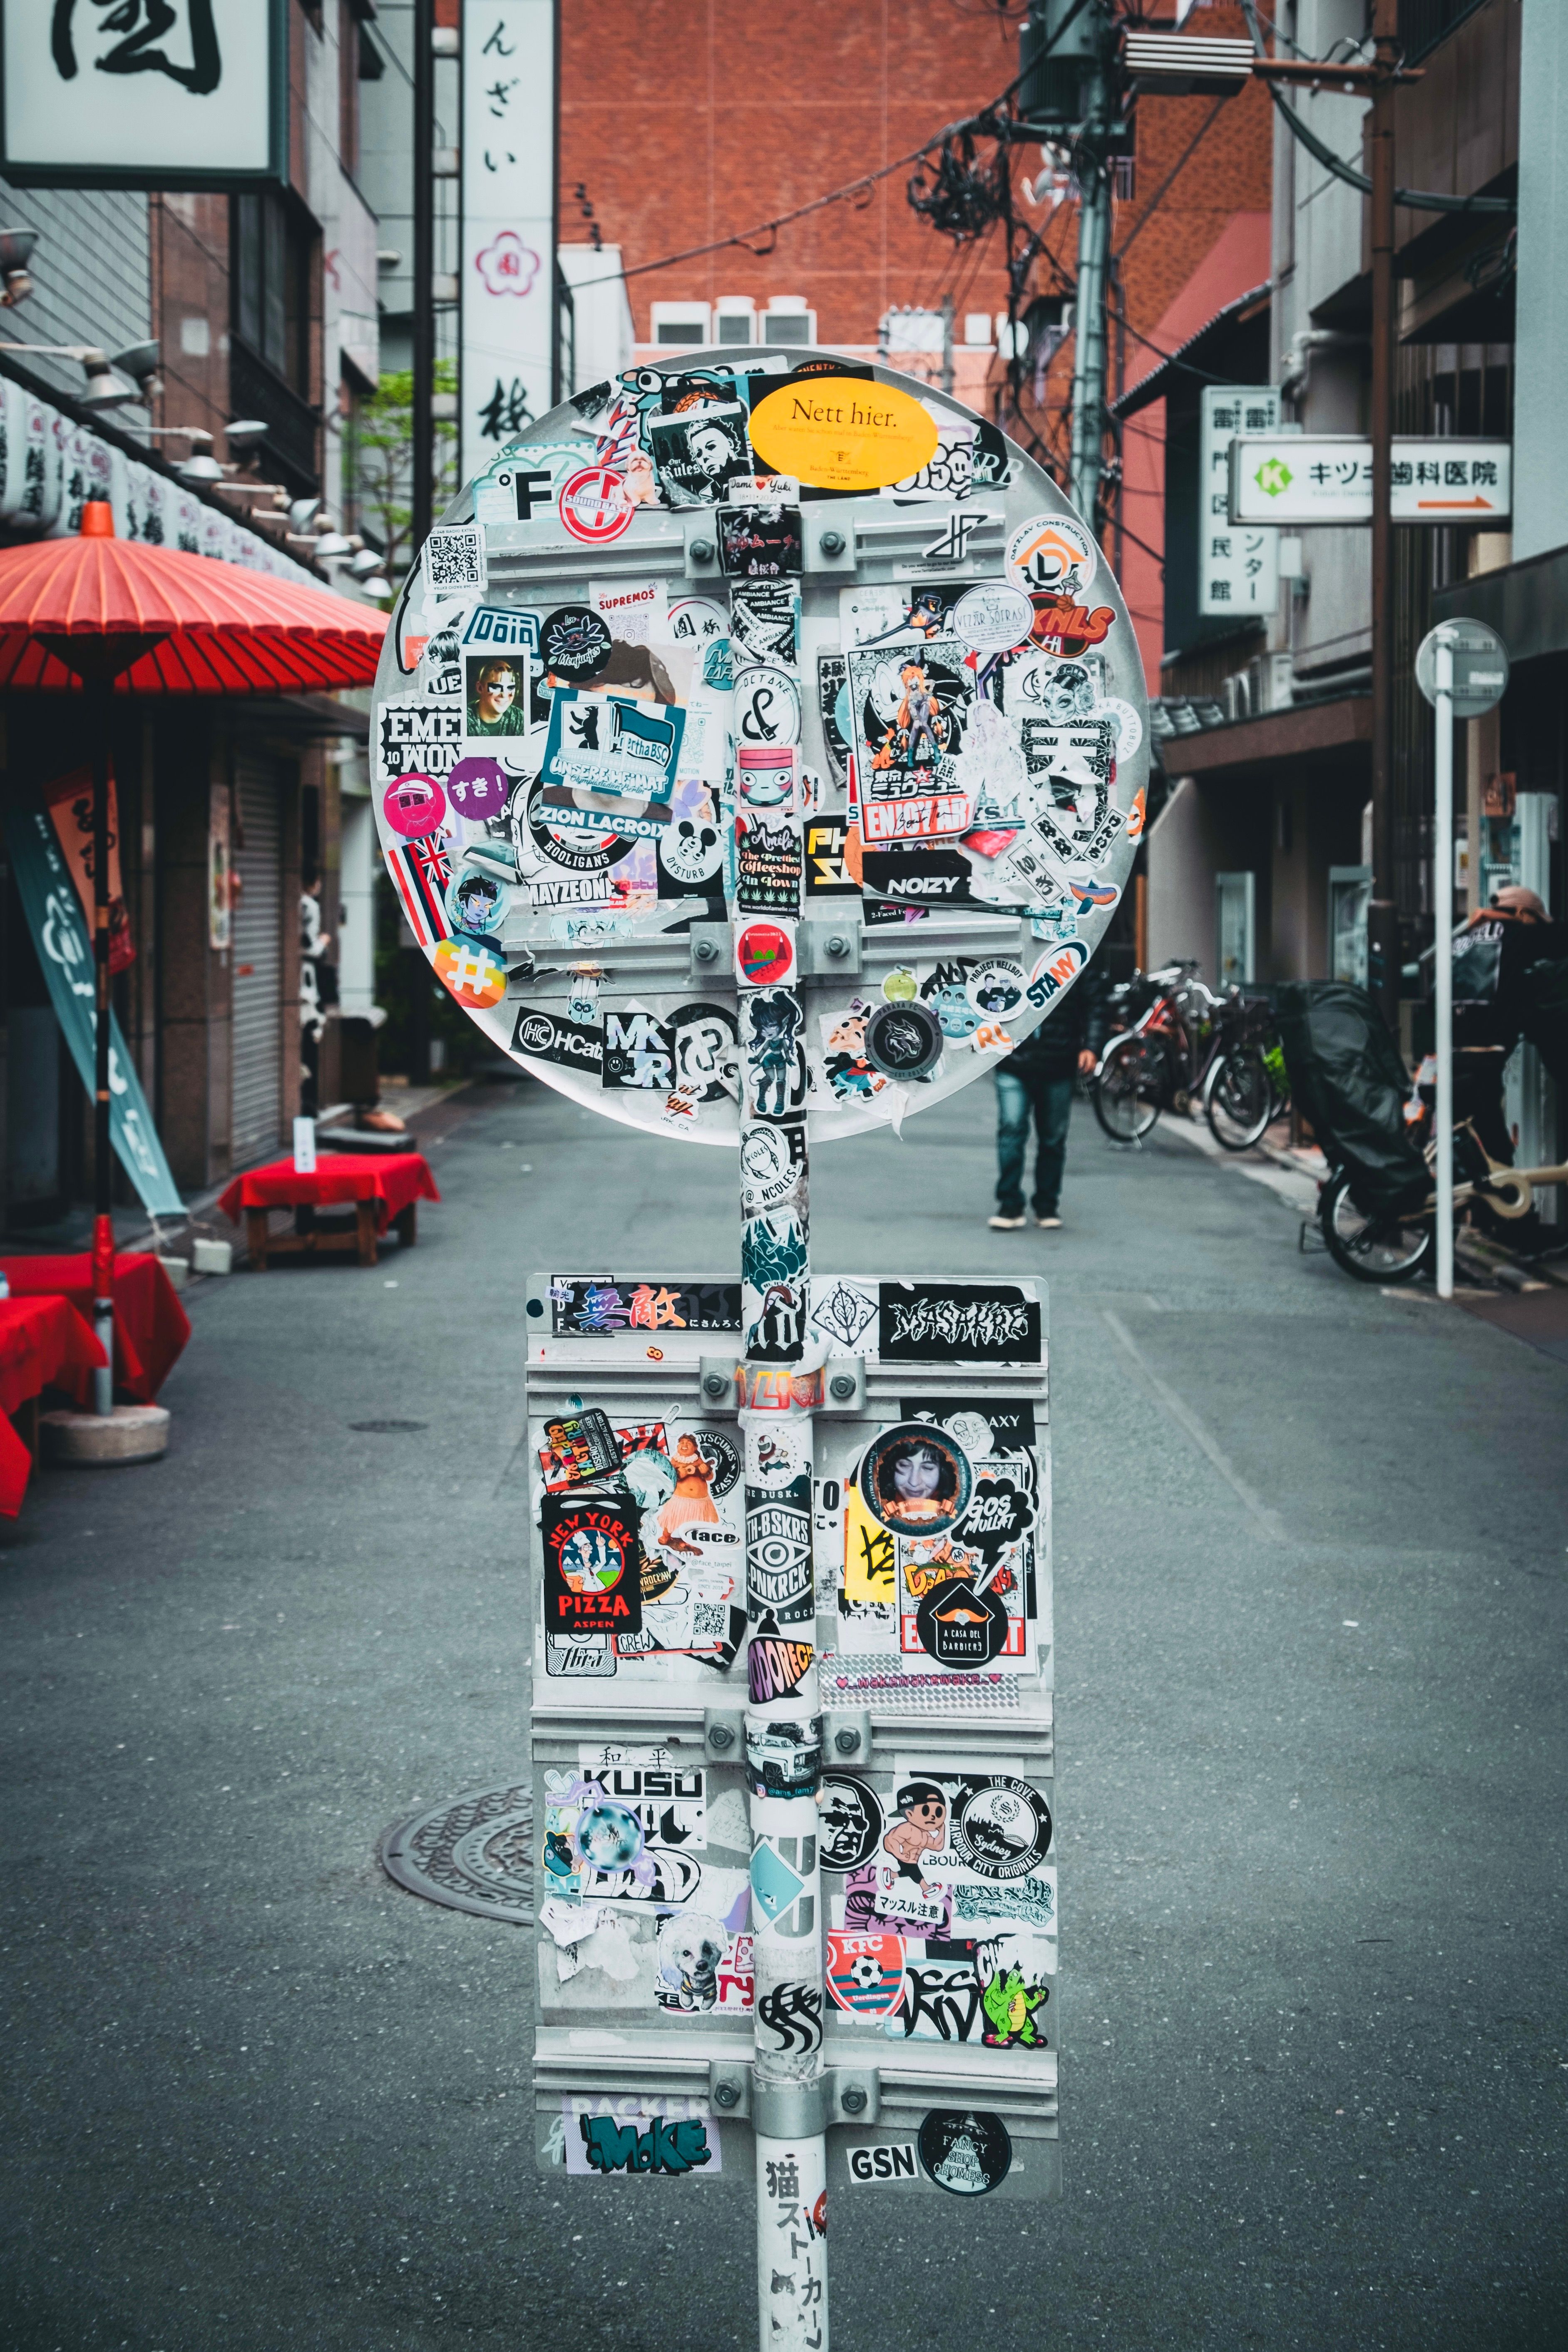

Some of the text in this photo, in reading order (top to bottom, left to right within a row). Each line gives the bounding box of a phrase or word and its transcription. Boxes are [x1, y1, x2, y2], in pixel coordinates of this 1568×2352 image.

[792, 398, 898, 427] Nett hier.
[1036, 520, 1089, 556] CONSTRUCTION
[599, 589, 655, 610] SUPREMOS
[564, 615, 577, 625] Los
[744, 674, 791, 695] OCTANE
[388, 712, 462, 743] EME
[387, 751, 400, 765] 10
[549, 756, 605, 781] UNSERE
[539, 807, 670, 837] ZION LACROIX
[867, 800, 932, 838] ENJOY
[543, 840, 610, 868] HOOLIGANS
[741, 851, 800, 863] The Prettiest
[666, 857, 705, 879] DYSTURB
[740, 859, 801, 876] Coffeeshop
[742, 874, 798, 888] In Town
[887, 877, 960, 894] NOIZY
[969, 961, 1023, 983] PROJECT HELLBOY
[877, 1003, 919, 1017] PARAXA FC
[574, 1284, 686, 1330] 無敵
[689, 1318, 742, 1328] にさんろく
[696, 1431, 737, 1462] OYSCUMS
[716, 1473, 736, 1493] FAST
[969, 1495, 1012, 1518] GOS
[549, 1512, 634, 1549] NEW YORK
[691, 1530, 737, 1544] face
[559, 1595, 630, 1617] PIZZA
[785, 1607, 814, 1620] ROCK
[619, 1634, 653, 1652] CREW
[944, 1629, 981, 1639] A CASA DEL
[988, 1776, 1036, 1802] THE COVE
[949, 1819, 1043, 1879] HARBOUR CITY ORIGINALS
[974, 1834, 1012, 1860] Sydney
[880, 1895, 939, 1918] マッスル注意
[843, 1935, 883, 1954] KFC
[852, 1992, 890, 2002] Uerdingen
[943, 2136, 989, 2155] FANCY
[851, 2146, 916, 2180] GSN
[948, 2151, 980, 2166] SHOP
[934, 2163, 991, 2185] CHOMESS
